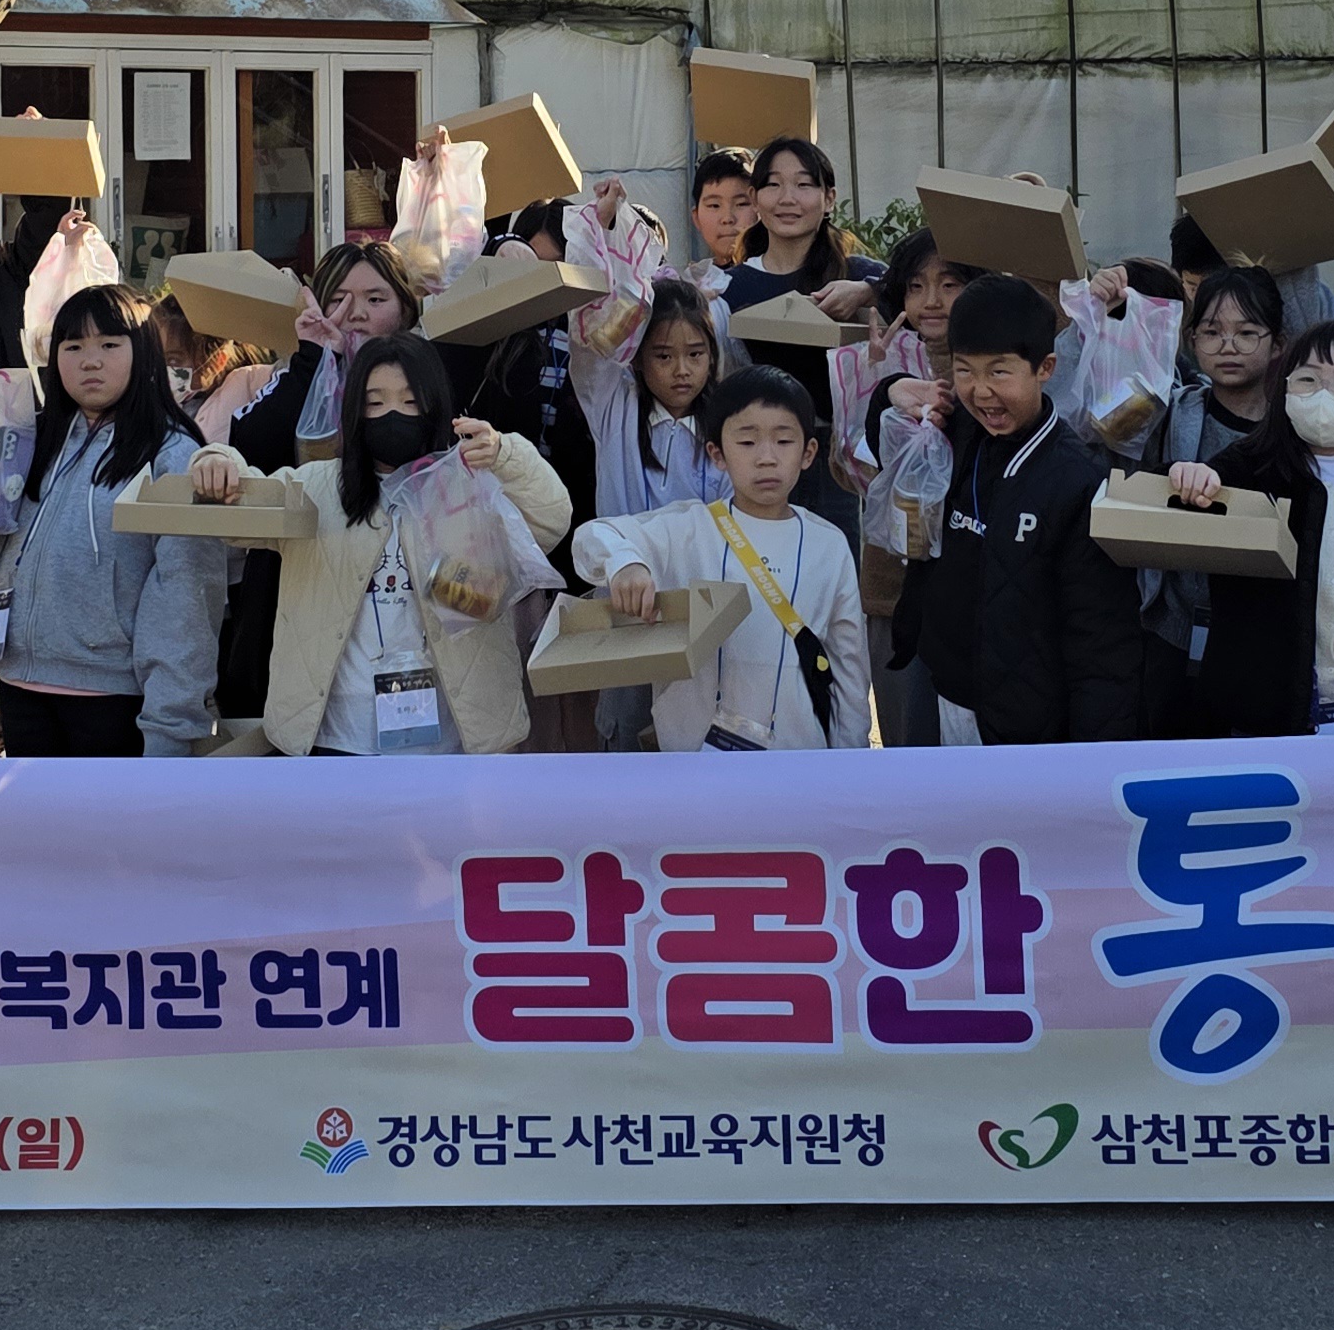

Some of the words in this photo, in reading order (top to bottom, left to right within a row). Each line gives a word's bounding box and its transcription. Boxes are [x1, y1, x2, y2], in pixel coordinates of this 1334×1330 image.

[1014, 512, 1038, 542] P
[459, 846, 1044, 1045] 달콤한
[250, 947, 401, 1029] 연계
